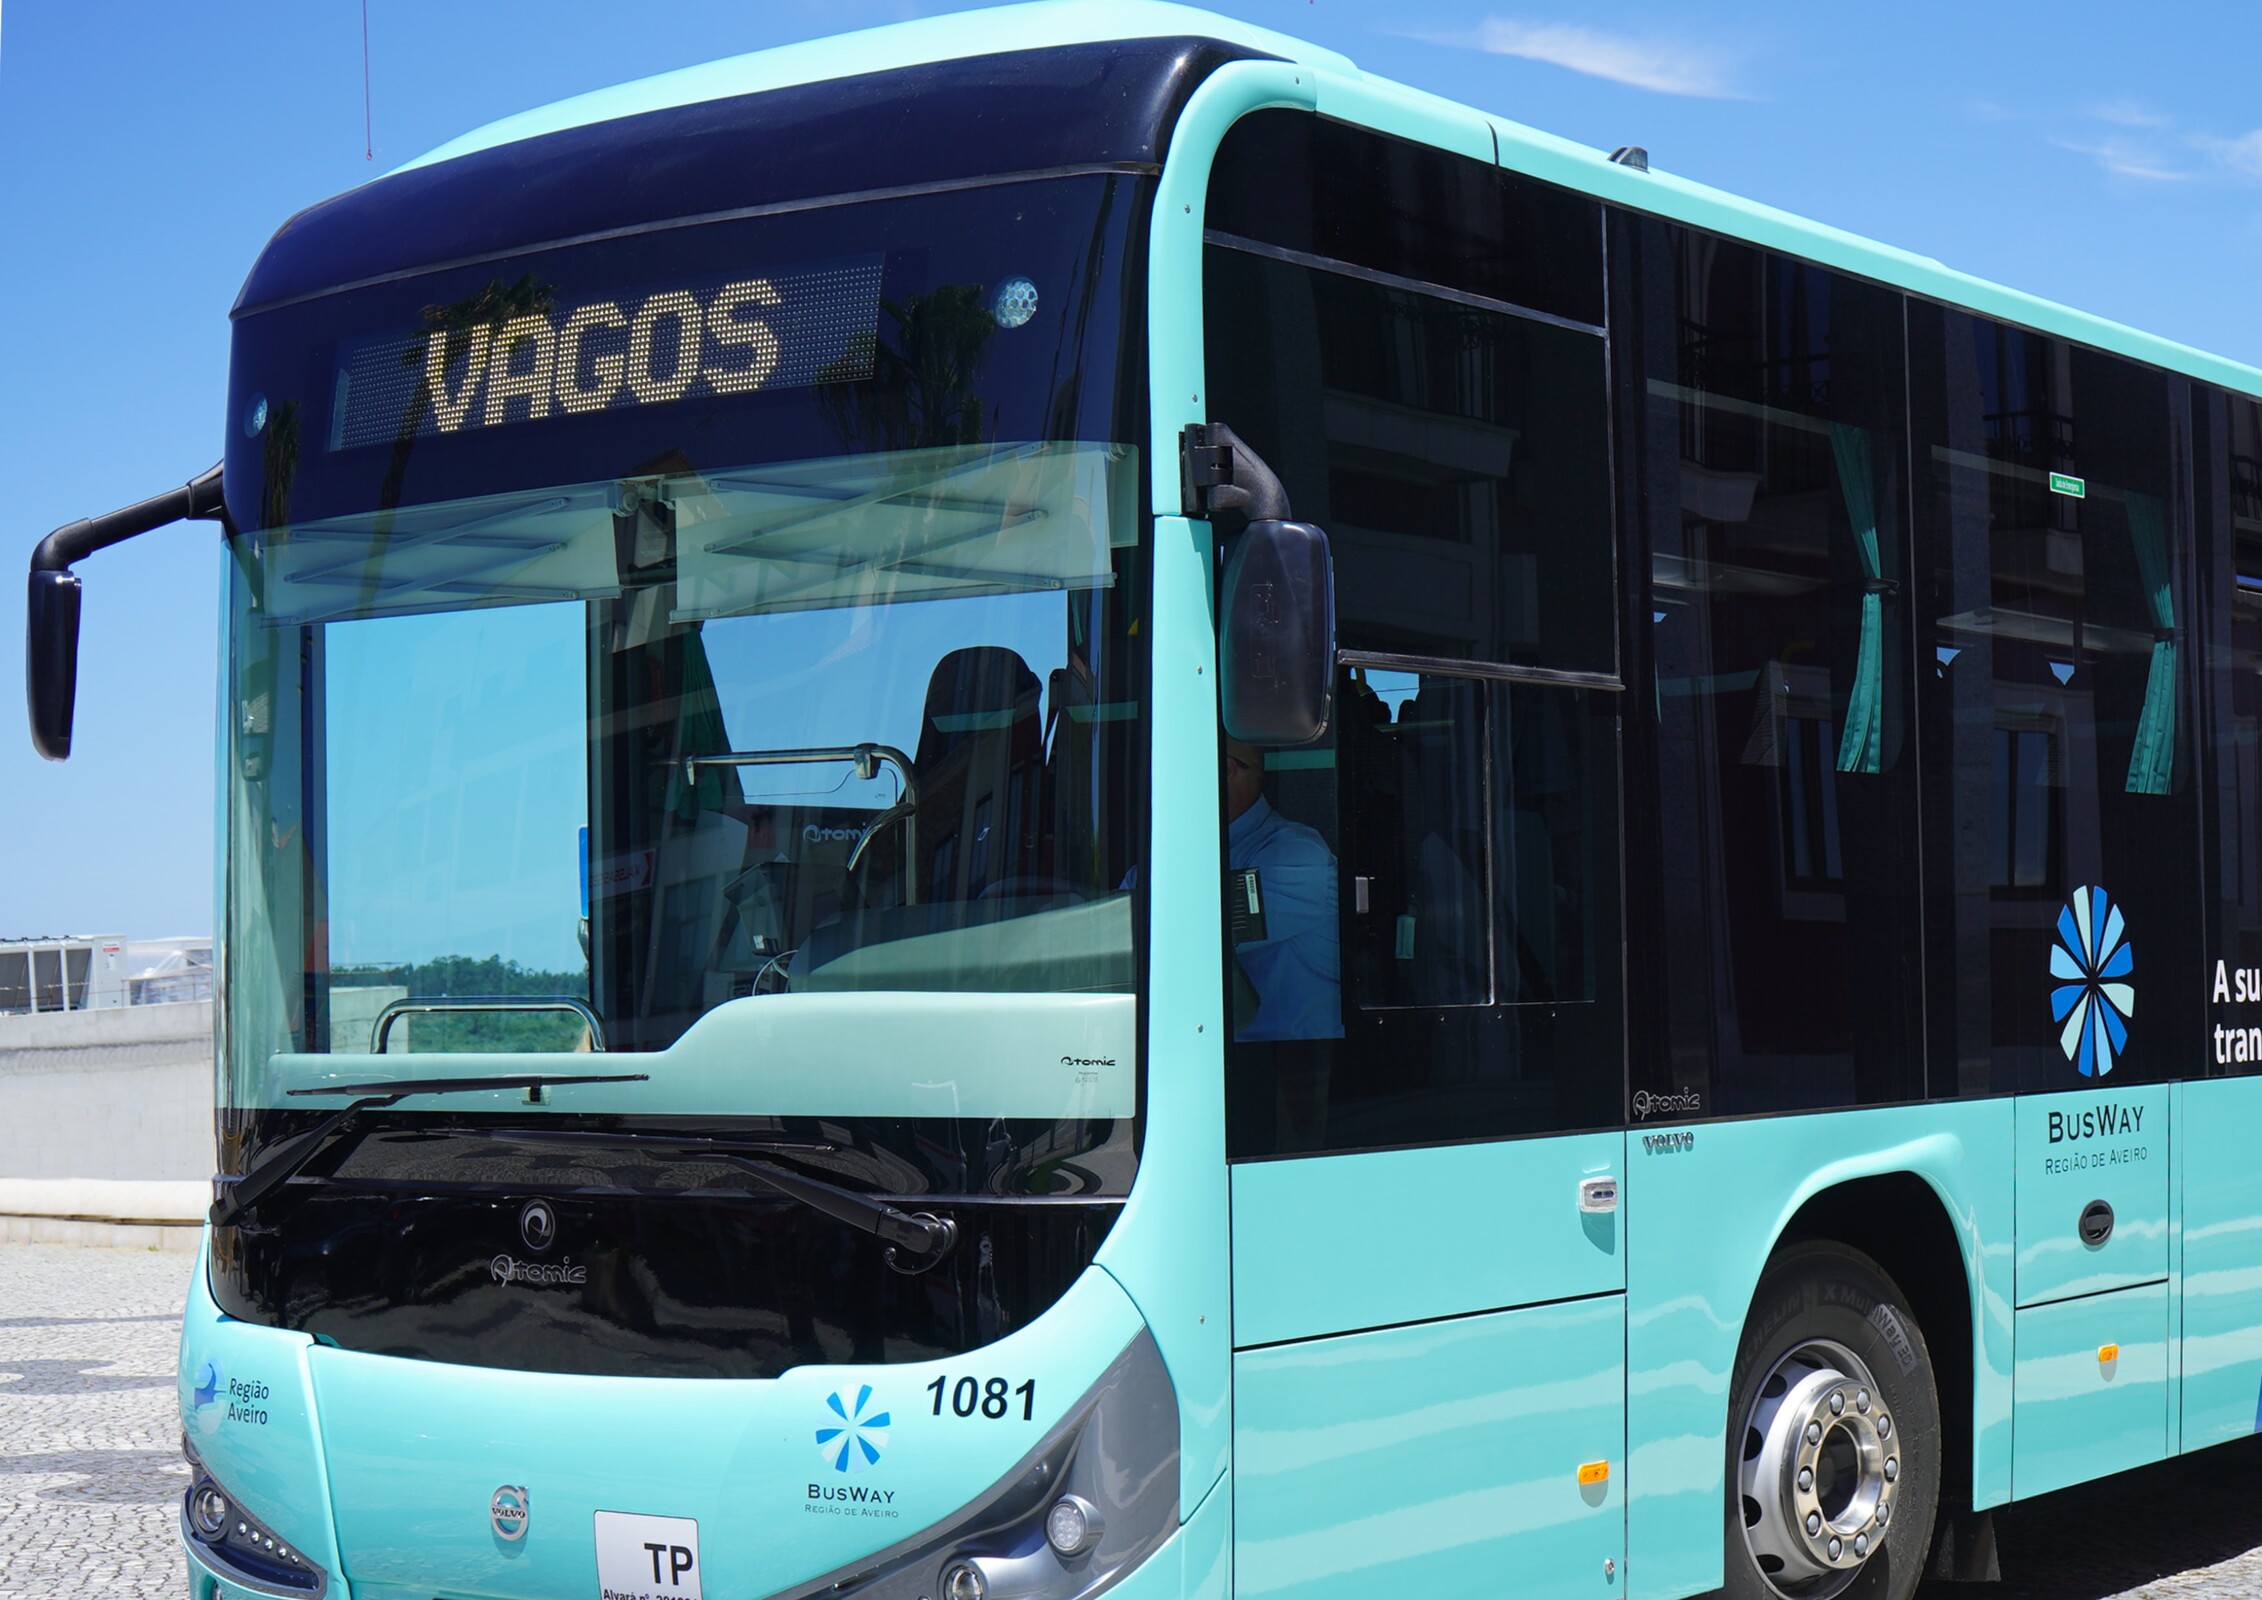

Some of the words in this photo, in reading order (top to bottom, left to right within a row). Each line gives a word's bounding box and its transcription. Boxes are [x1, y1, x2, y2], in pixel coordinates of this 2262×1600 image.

[426, 278, 781, 432] VAGOS
[803, 822, 869, 843] Atomi
[2213, 959, 2231, 1004] A
[2235, 967, 2262, 1003] su
[1632, 1086, 1701, 1121] Atomic
[1642, 1131, 1695, 1150] VOLVO
[490, 1254, 587, 1288] Atomic
[229, 1378, 270, 1403] Região
[926, 1375, 1037, 1421] 1081
[227, 1402, 268, 1425] Aveiro
[491, 1507, 526, 1519] VOLVO
[644, 1542, 694, 1586] TP
